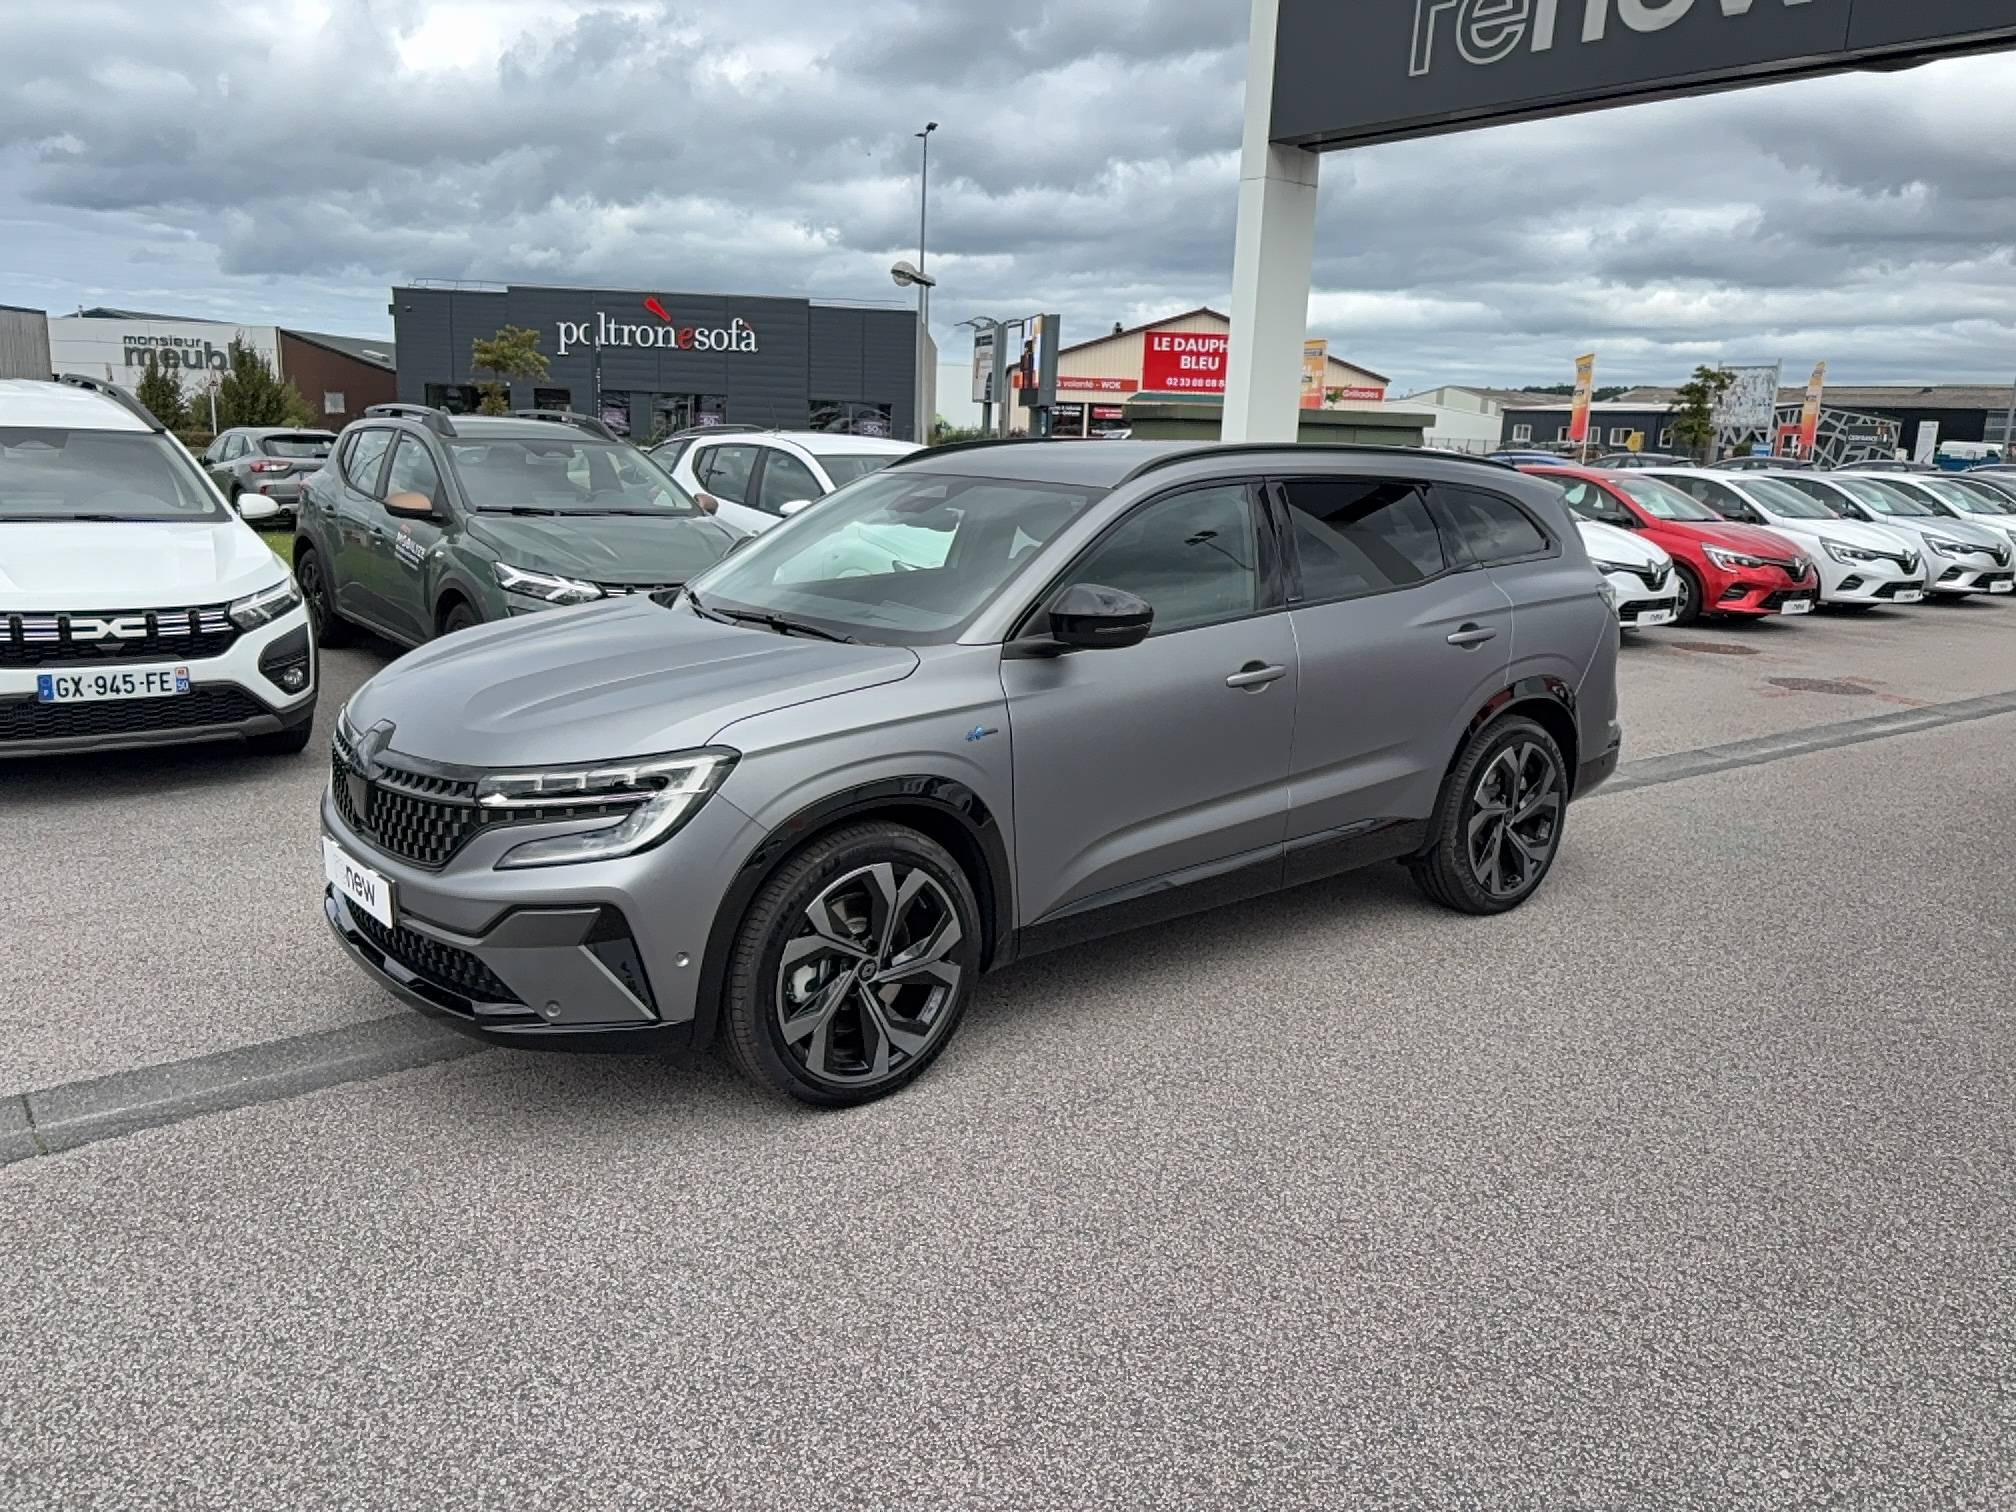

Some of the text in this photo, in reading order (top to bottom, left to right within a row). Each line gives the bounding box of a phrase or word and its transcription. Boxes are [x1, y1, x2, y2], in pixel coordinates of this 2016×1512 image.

[1407, 0, 1814, 77] ren
[123, 334, 202, 348] monsieur
[1153, 336, 1171, 352] LE
[1179, 355, 1220, 370] BLEU
[56, 671, 172, 699] GX-945-FE
